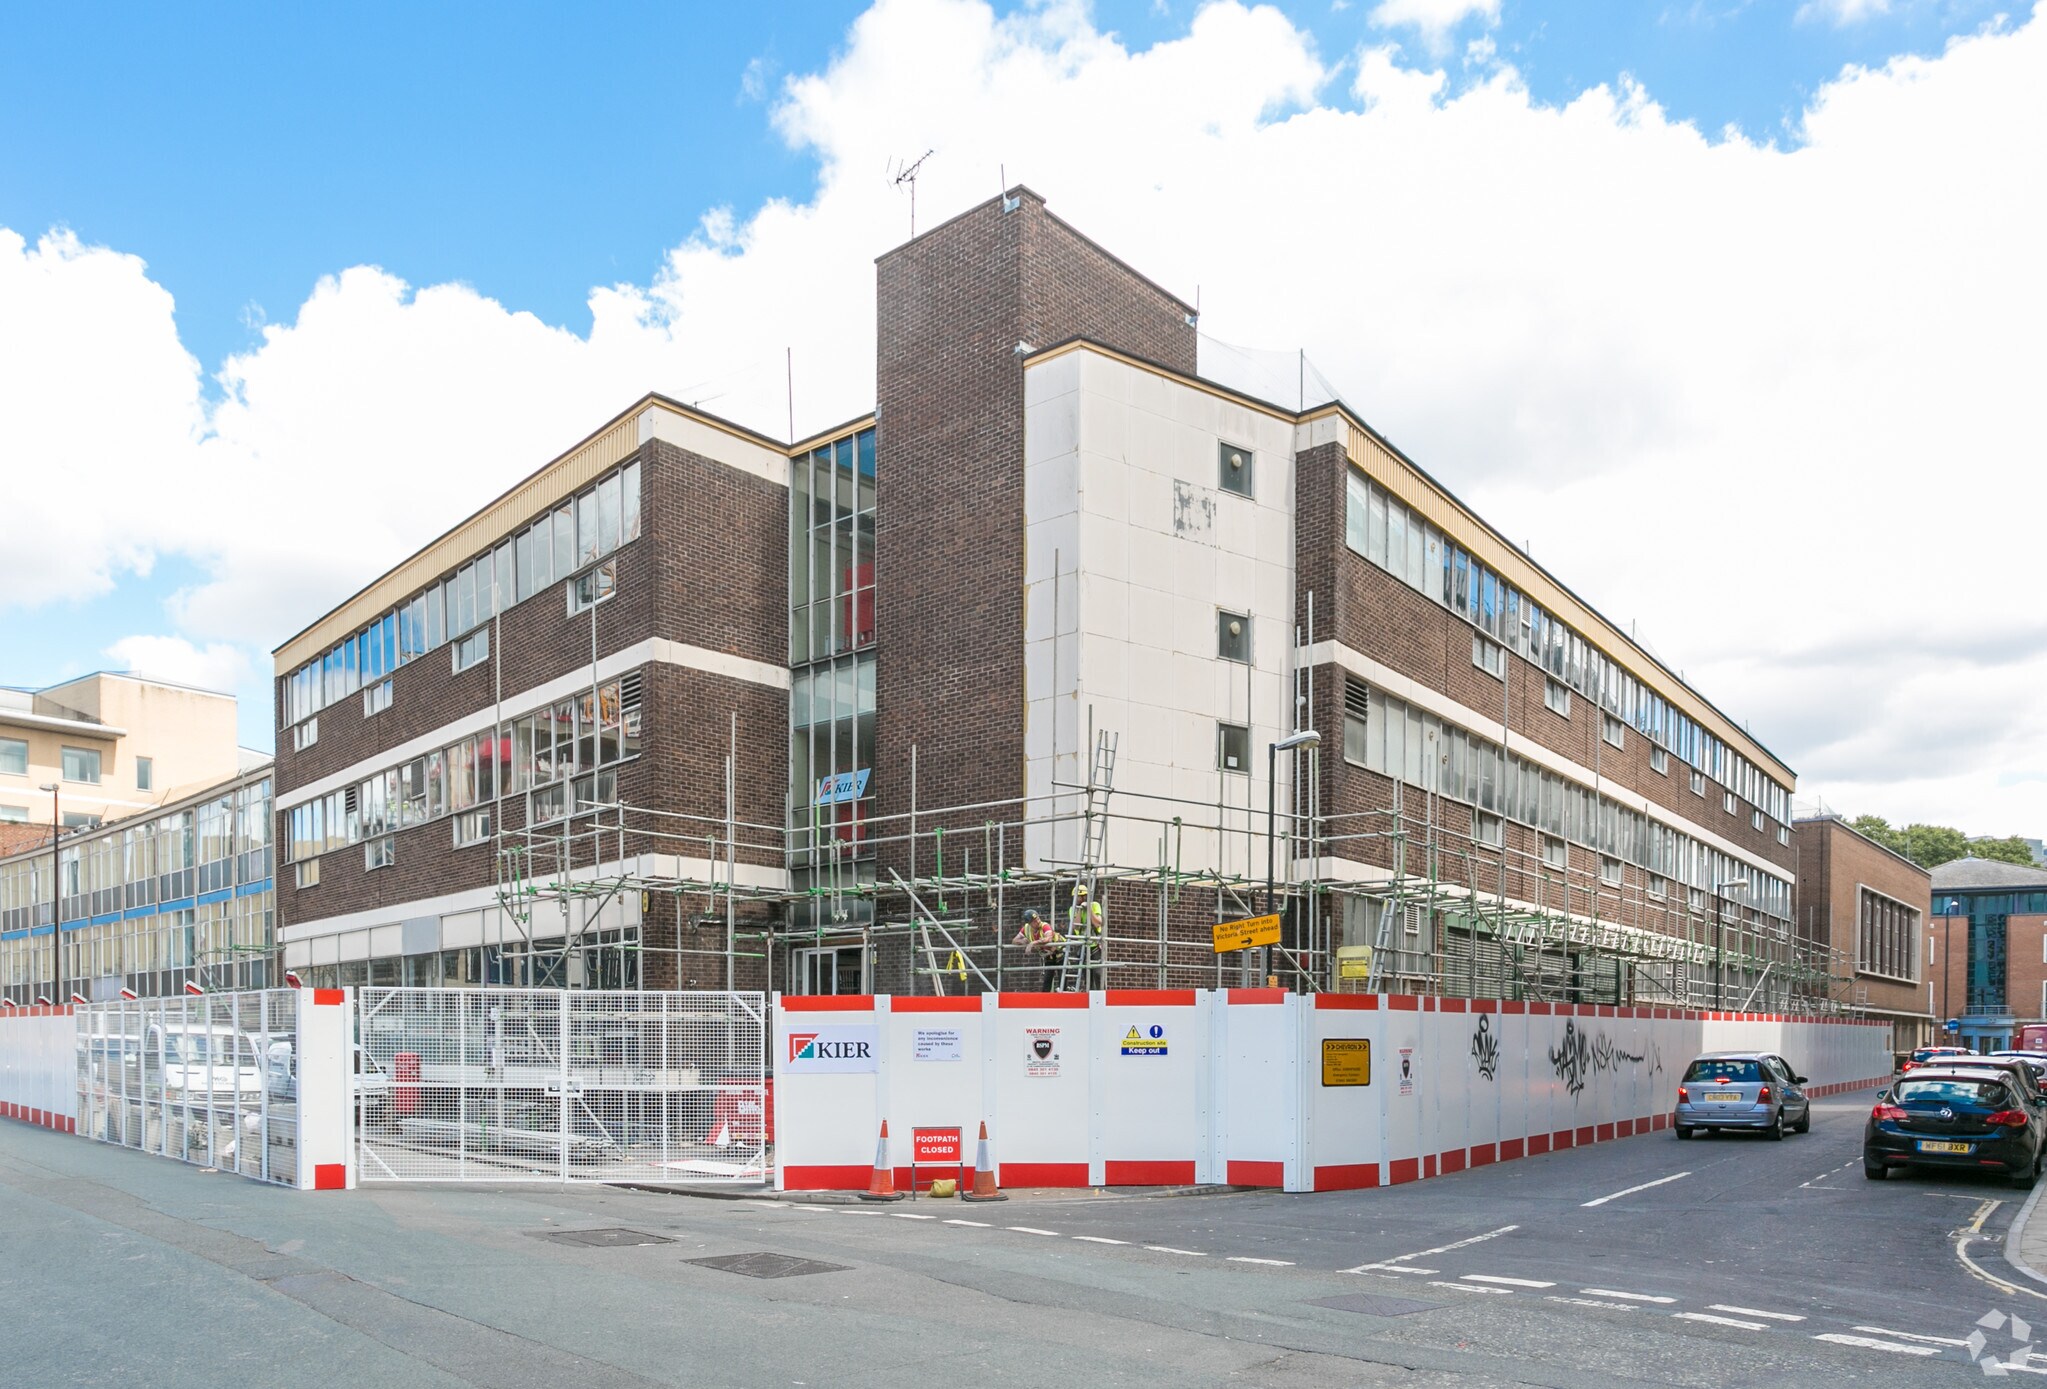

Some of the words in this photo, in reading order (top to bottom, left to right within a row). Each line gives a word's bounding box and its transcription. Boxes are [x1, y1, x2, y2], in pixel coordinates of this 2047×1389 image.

[835, 780, 862, 794] KIER
[1230, 923, 1245, 931] Right
[1216, 931, 1238, 940] Victoria
[1240, 928, 1258, 936] Street
[1260, 924, 1278, 933] ahead
[817, 1042, 871, 1058] KIER
[1128, 1047, 1147, 1055] Keep
[915, 1135, 958, 1143] FOOTPATH
[921, 1146, 954, 1154] CLOSED
